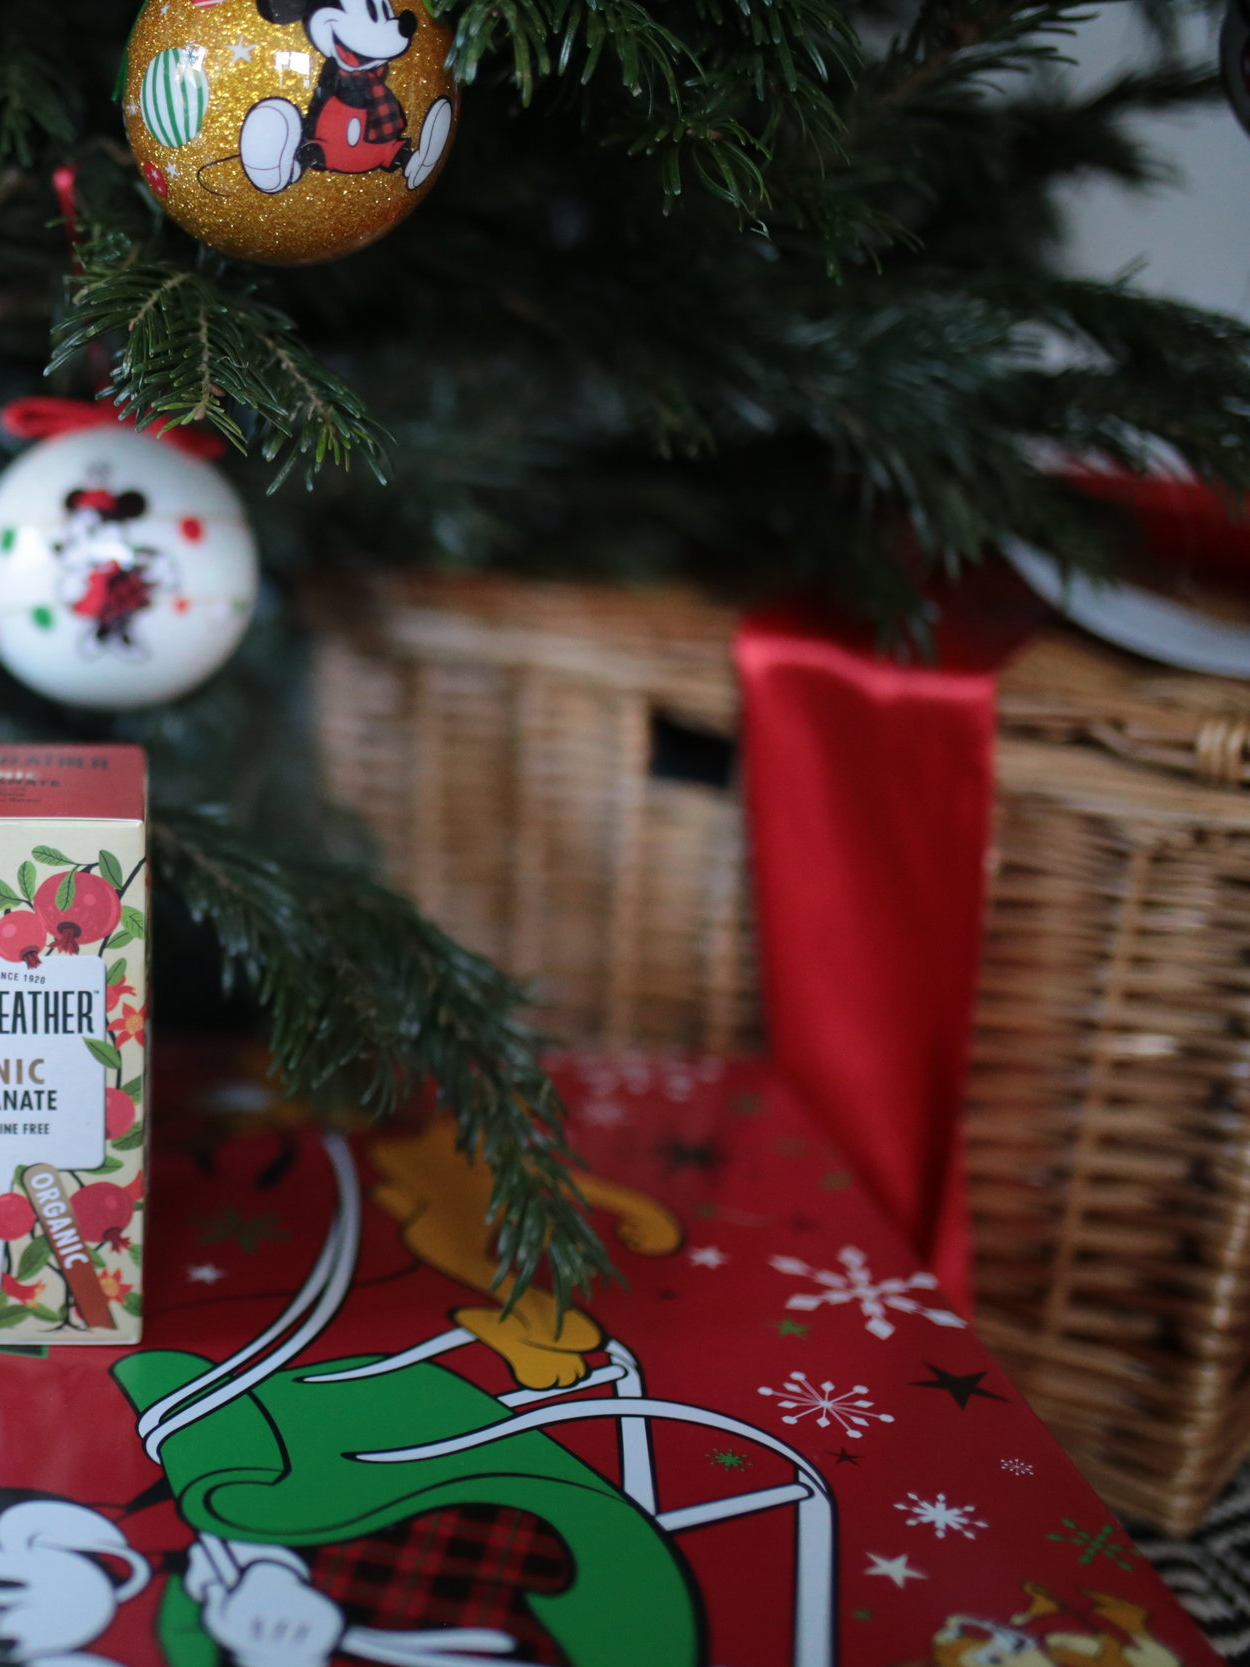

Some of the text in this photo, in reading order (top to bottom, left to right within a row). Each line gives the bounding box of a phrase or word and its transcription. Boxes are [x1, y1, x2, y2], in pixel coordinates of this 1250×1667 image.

[23, 974, 46, 985] 1920
[23, 1123, 50, 1135] FREE
[31, 1172, 89, 1269] ORGANIC
